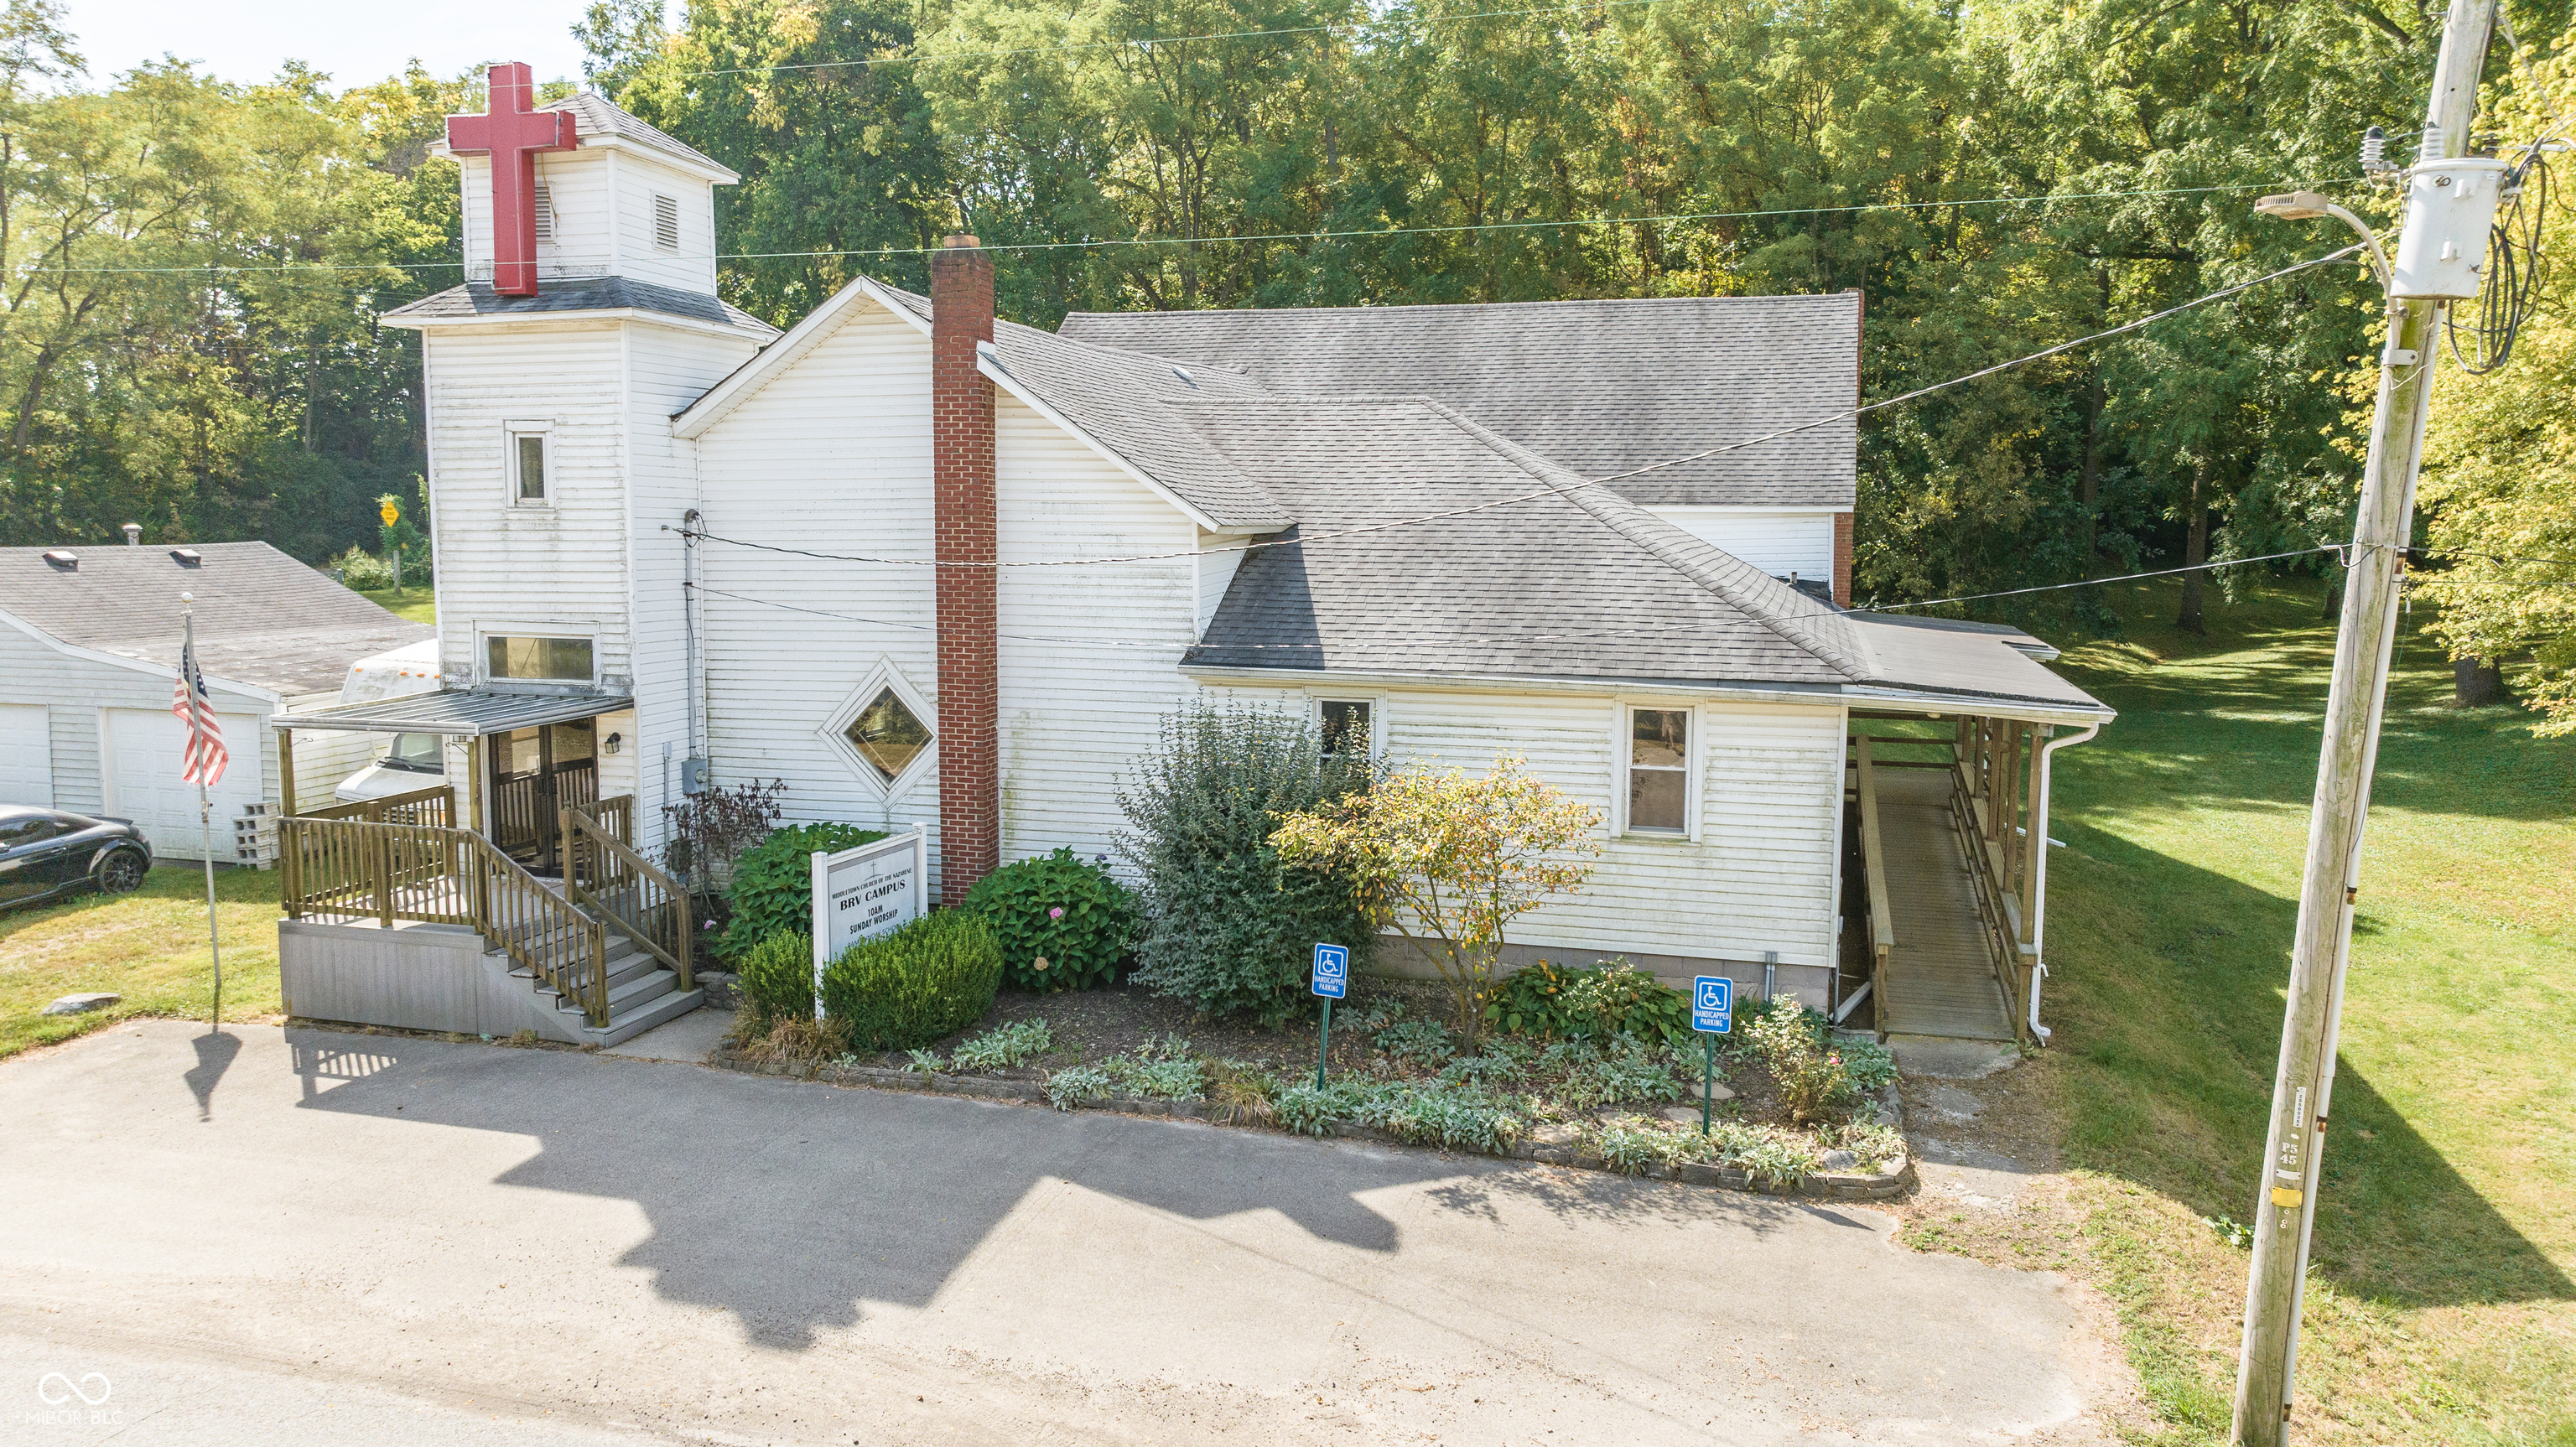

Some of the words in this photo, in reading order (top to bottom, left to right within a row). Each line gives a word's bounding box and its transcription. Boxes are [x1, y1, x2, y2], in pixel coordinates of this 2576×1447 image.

[832, 885, 860, 900] MIDDLETOWN
[860, 879, 878, 890] CHURCH
[892, 868, 912, 879] NAZARENE
[840, 894, 862, 911] BRV
[865, 879, 906, 902] CAMPUS
[868, 905, 883, 917] 10AM
[849, 918, 872, 935] SUNDAY
[873, 909, 898, 925] WORSHIP
[1315, 976, 1344, 986] HANDICAPPED
[1319, 983, 1339, 993] PARKING
[1695, 1010, 1729, 1019] HANDICAPPED
[1701, 1018, 1723, 1027] PARKING
[2281, 1141, 2298, 1154] P5
[2279, 1154, 2298, 1165] 45
